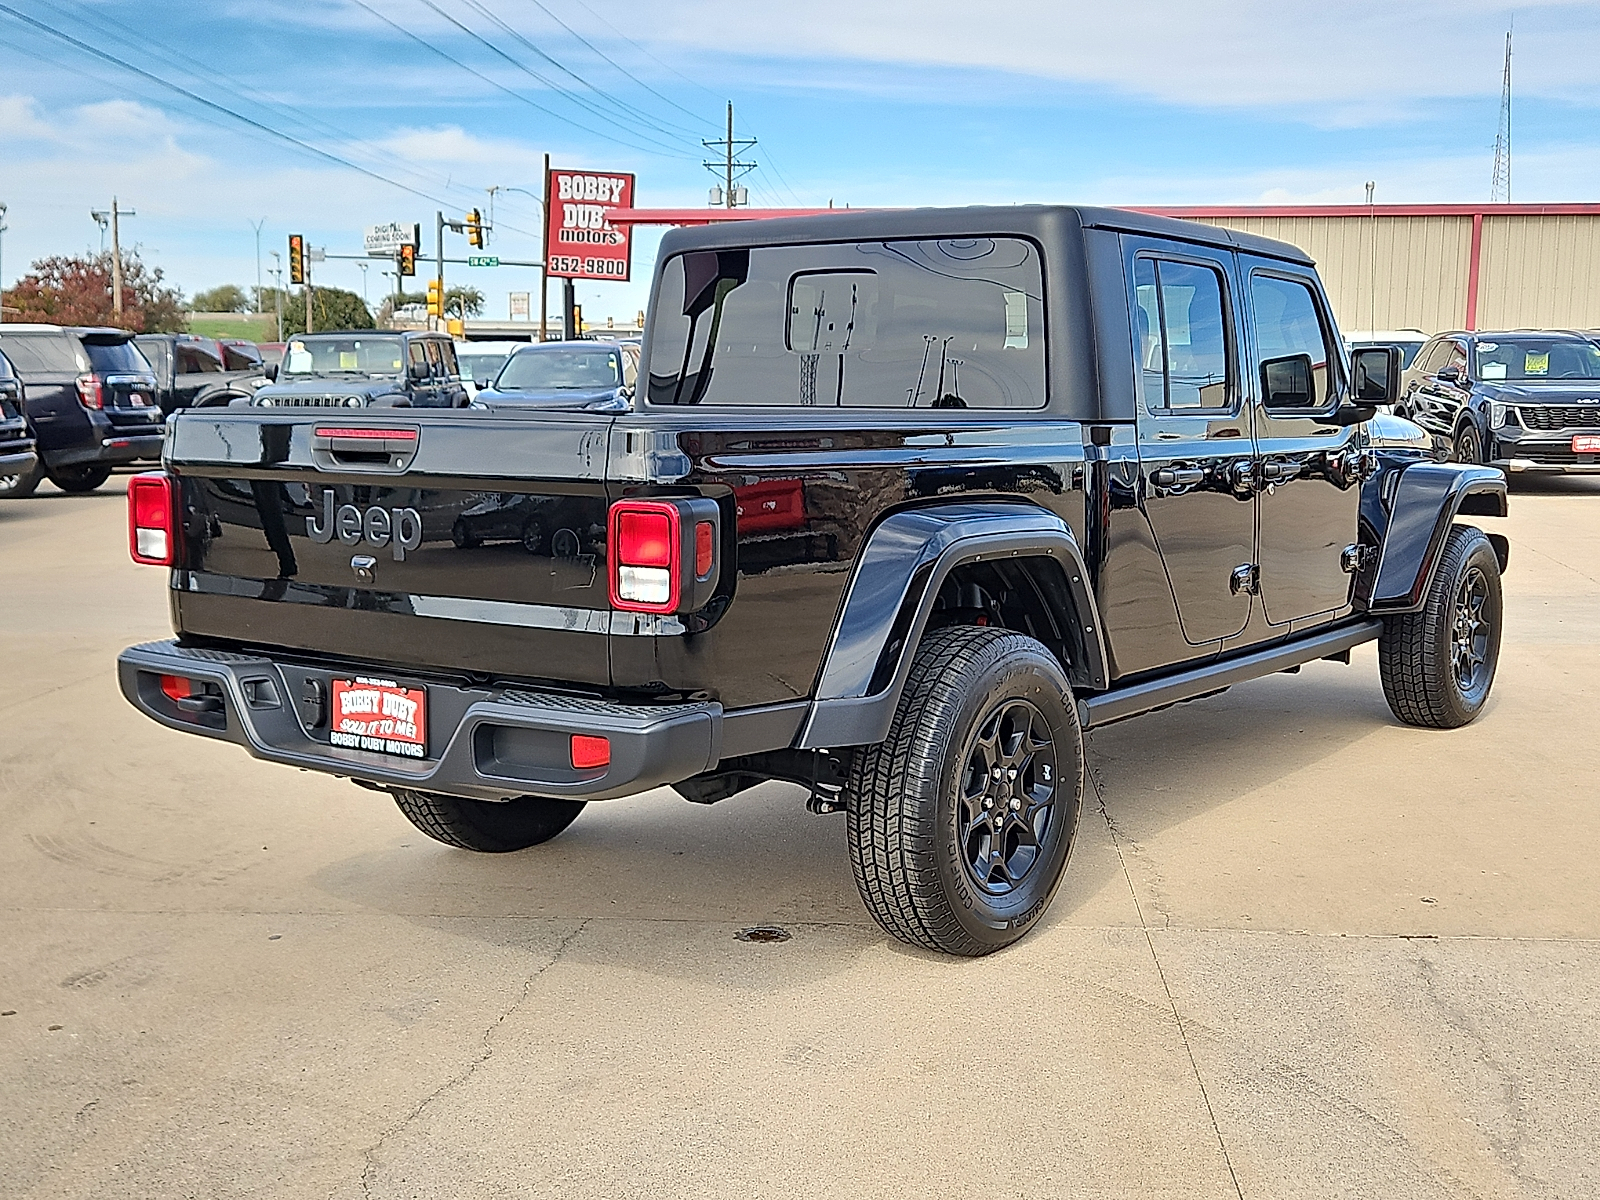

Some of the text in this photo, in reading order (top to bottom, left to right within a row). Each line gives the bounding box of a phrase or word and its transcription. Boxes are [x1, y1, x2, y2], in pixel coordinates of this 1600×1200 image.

[558, 175, 625, 203] BOBBY
[560, 229, 618, 244] motors
[550, 256, 625, 275] 352-9800
[305, 489, 422, 562] Jeep
[339, 689, 418, 723] BOBBY DUBY
[340, 718, 417, 740] SOLD IT TO ME!
[330, 732, 424, 757] BOBBY DUBY MOTORS
